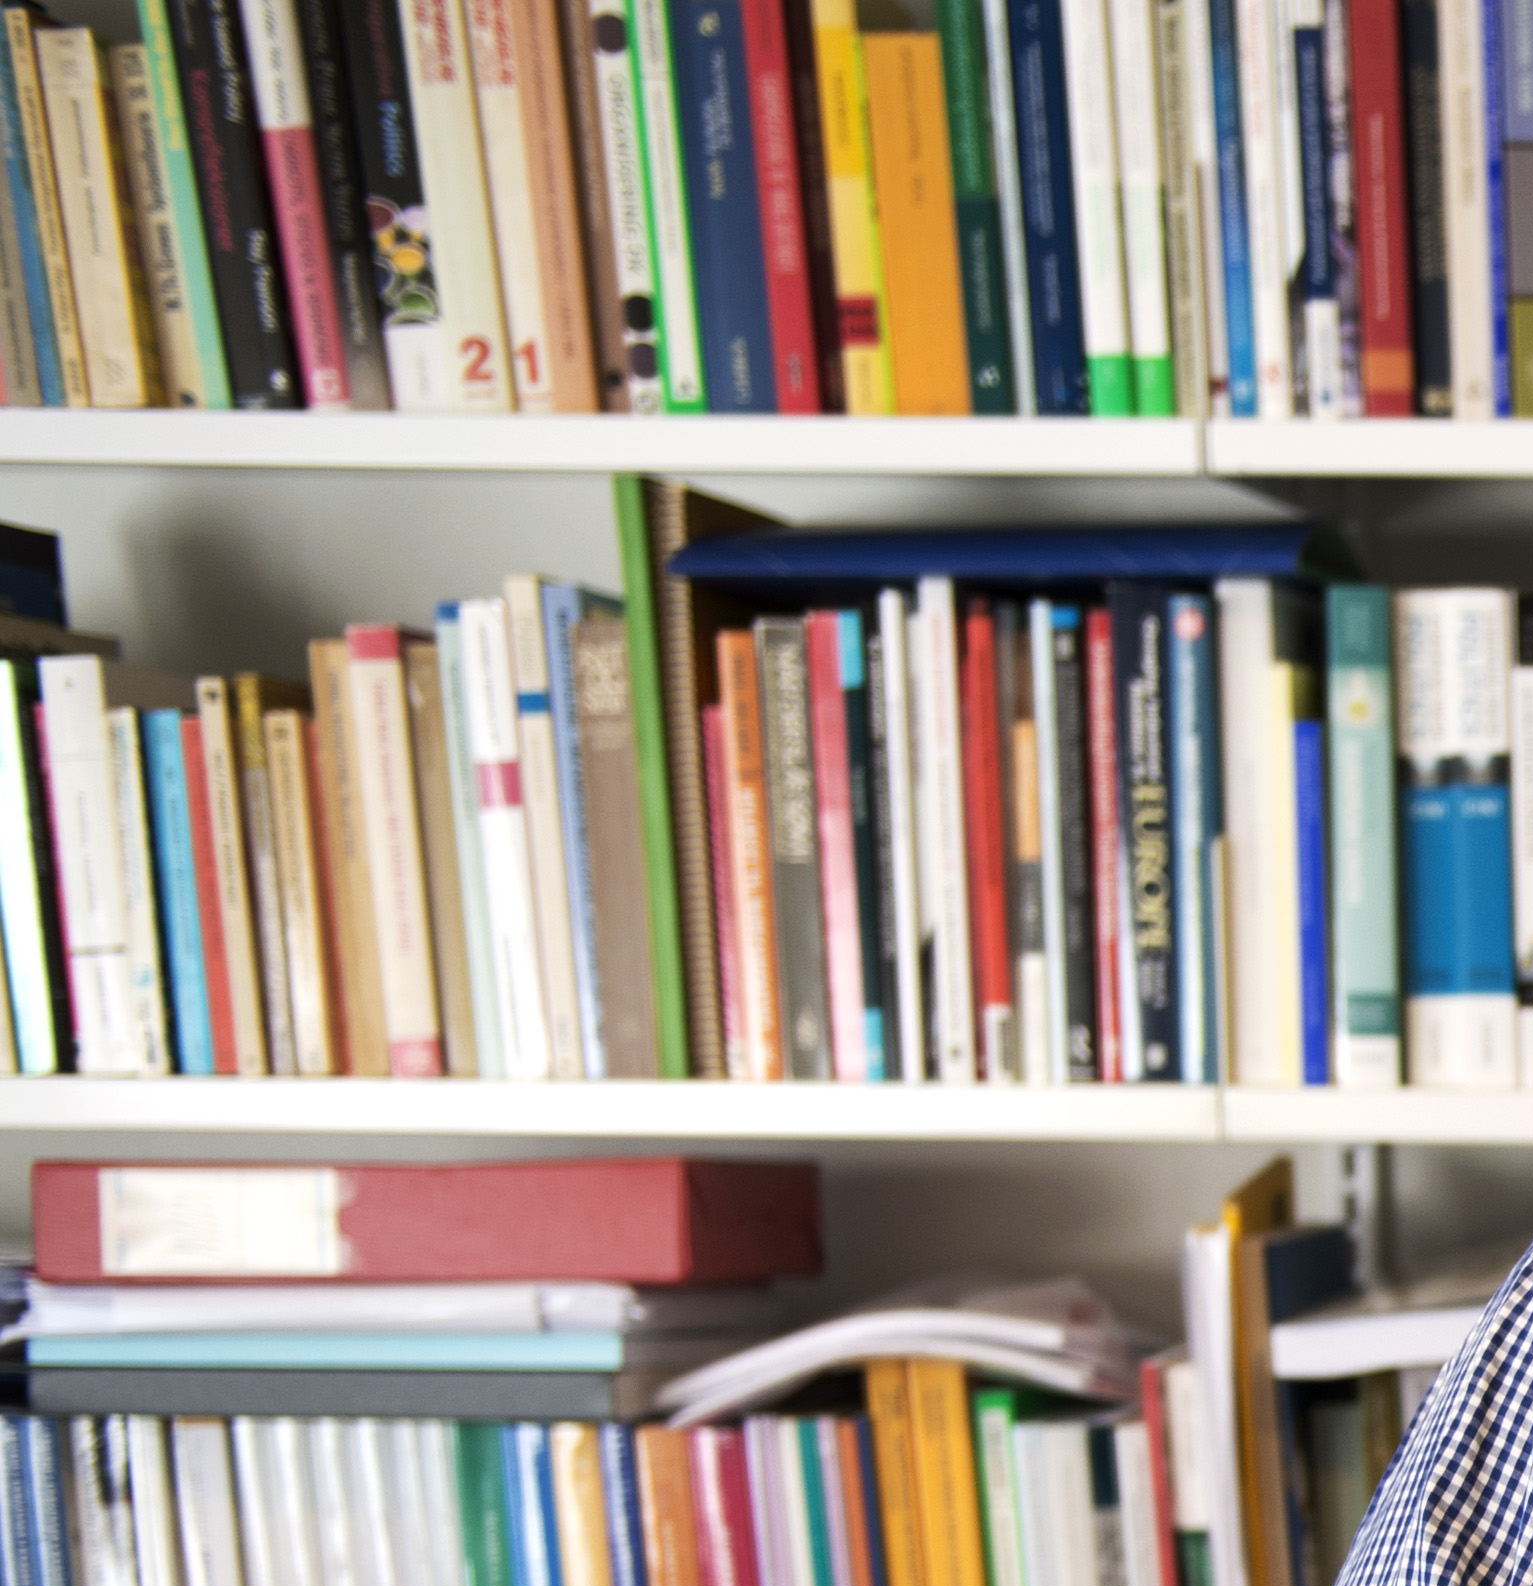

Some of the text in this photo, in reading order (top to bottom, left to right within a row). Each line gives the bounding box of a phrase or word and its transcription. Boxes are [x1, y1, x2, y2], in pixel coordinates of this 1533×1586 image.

[458, 336, 496, 384] 2
[513, 340, 542, 384] 1
[1131, 783, 1169, 951] EUROPE
